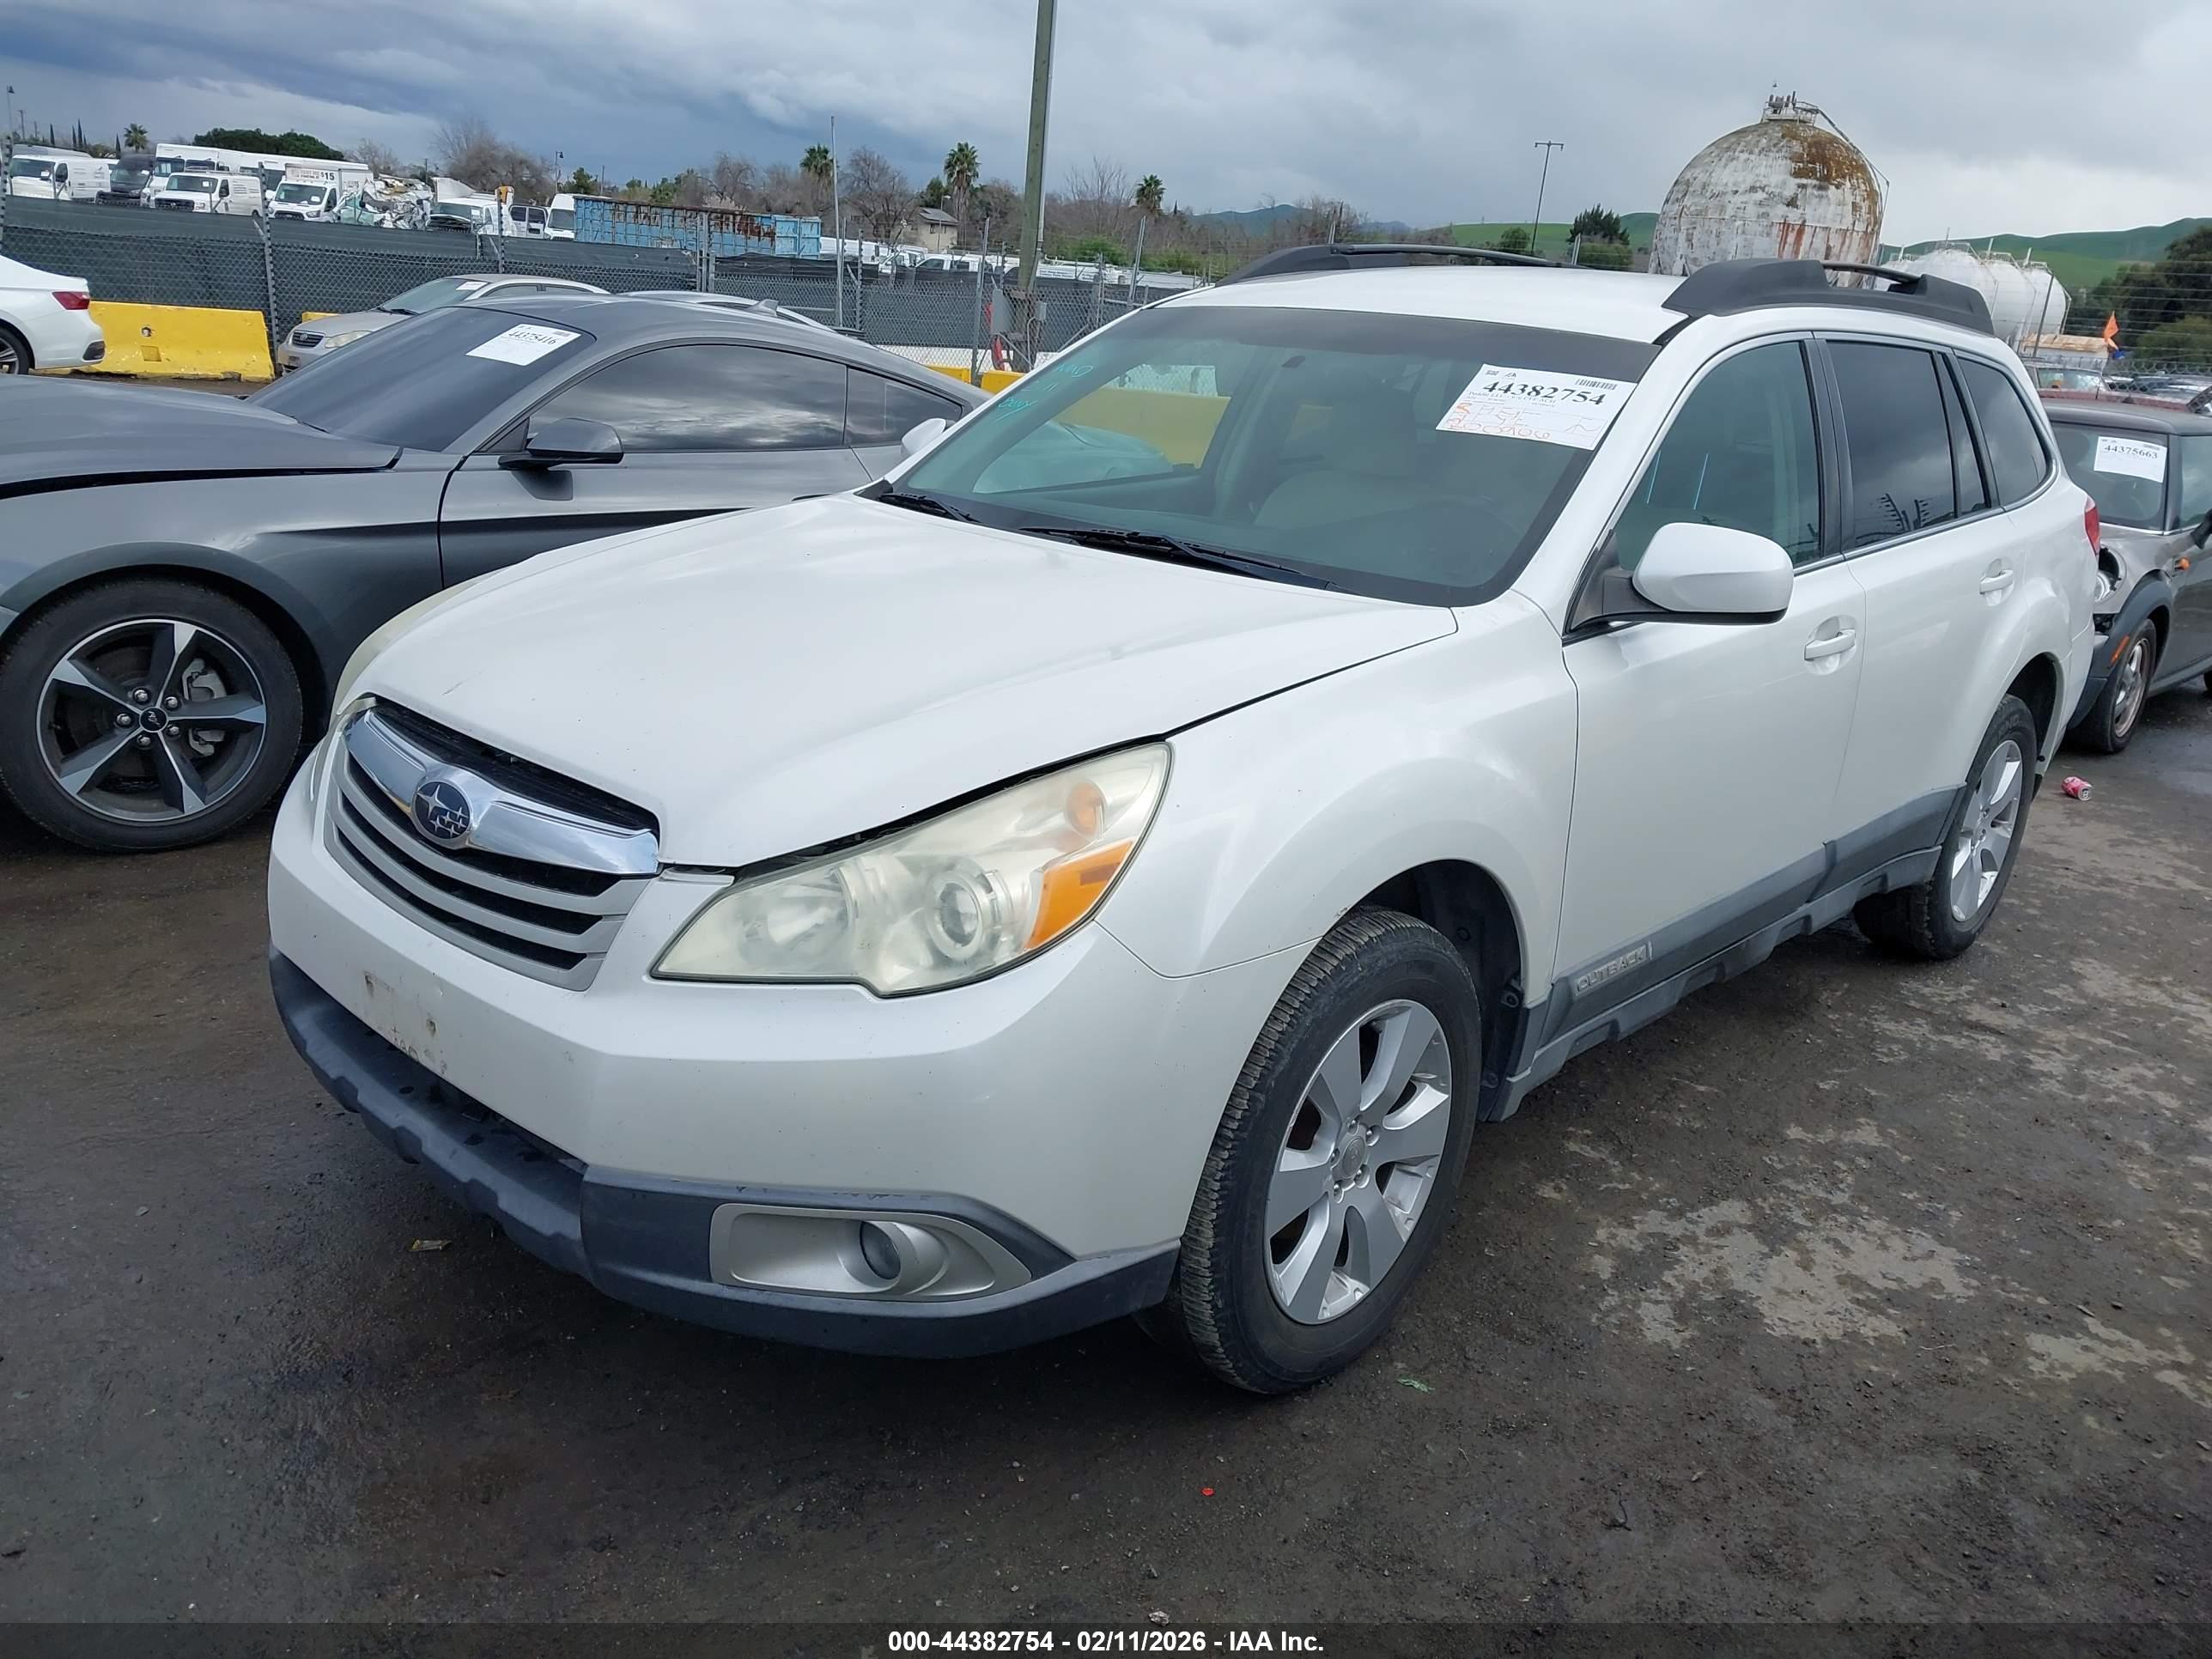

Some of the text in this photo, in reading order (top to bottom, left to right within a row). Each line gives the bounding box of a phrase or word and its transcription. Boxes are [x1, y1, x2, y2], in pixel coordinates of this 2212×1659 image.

[320, 172, 335, 180] $15
[1482, 380, 1607, 406] 44382754
[2104, 444, 2158, 459] 44375663
[1577, 945, 1647, 992] OUTBACK
